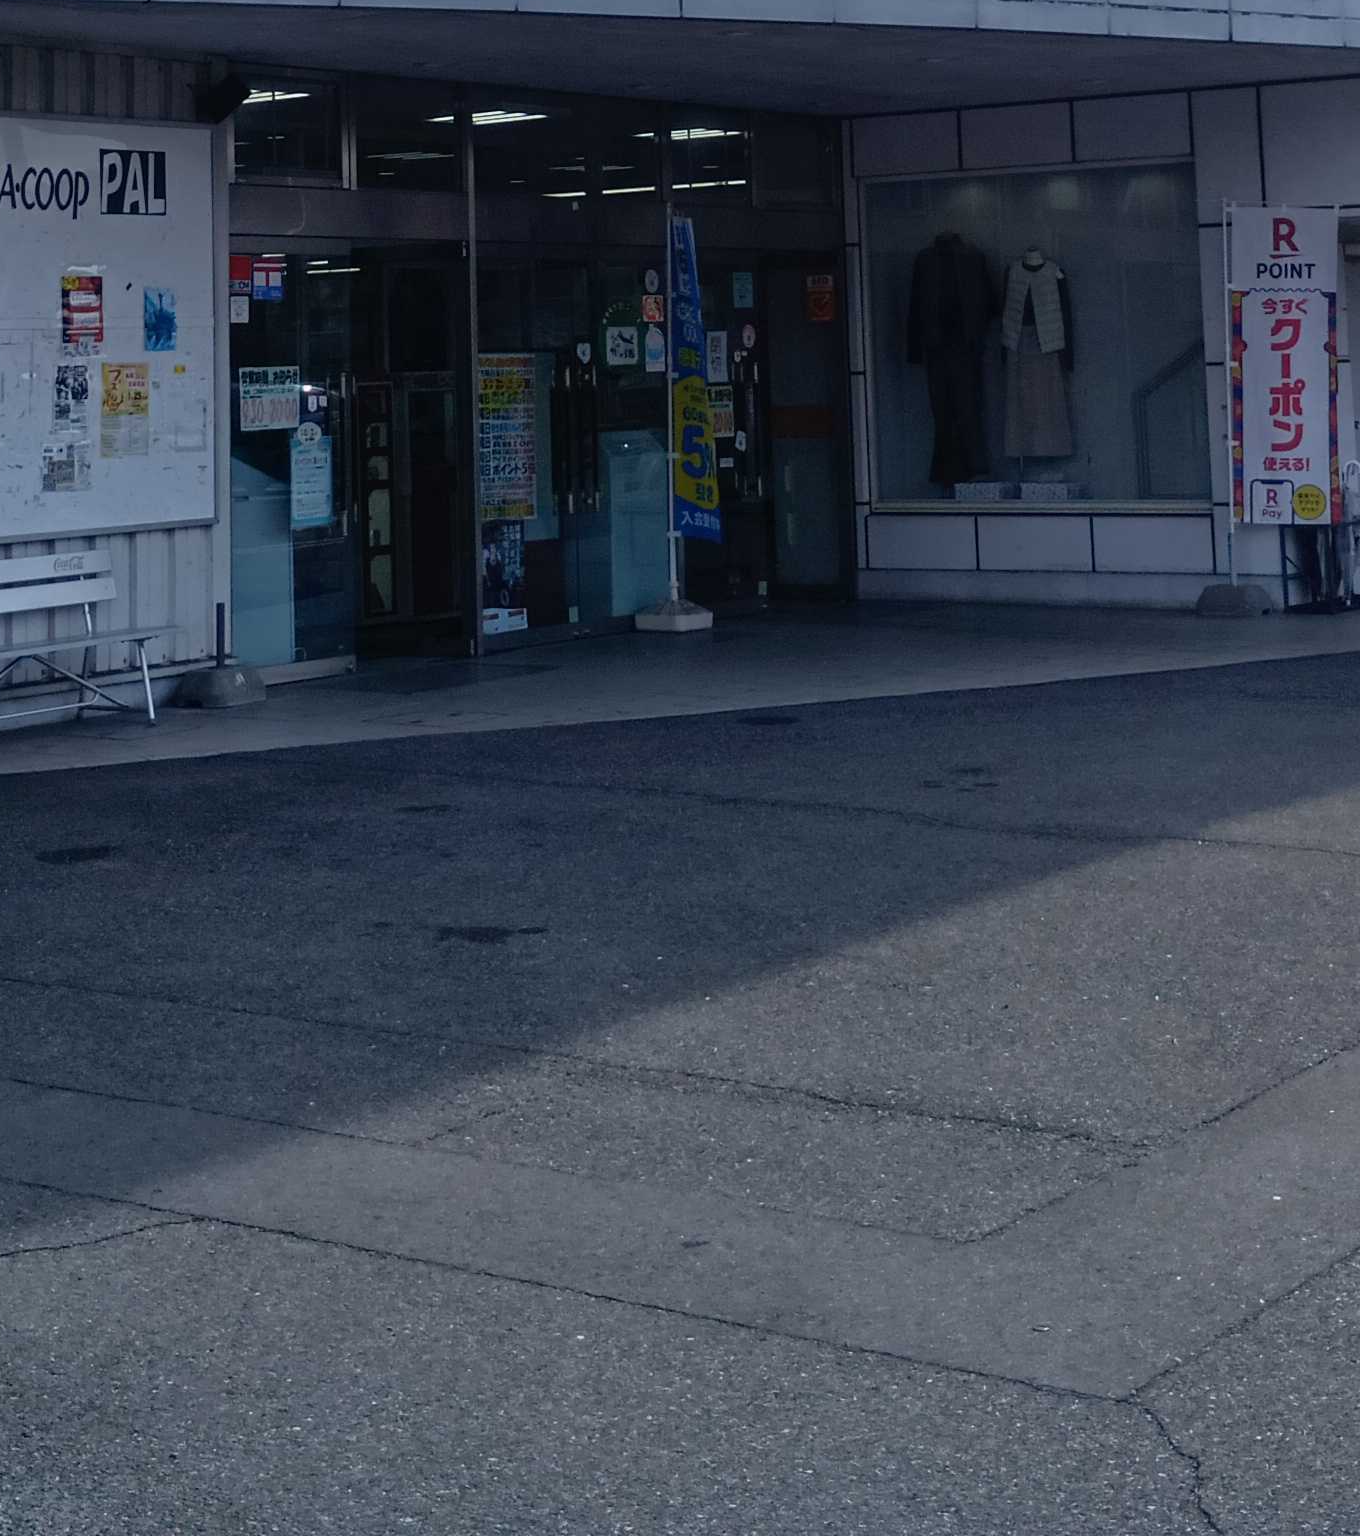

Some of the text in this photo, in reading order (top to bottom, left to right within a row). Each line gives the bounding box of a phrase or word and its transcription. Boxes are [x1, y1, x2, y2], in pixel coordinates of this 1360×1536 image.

[100, 150, 167, 215] PAL
[1272, 217, 1301, 253] R
[1256, 262, 1317, 281] POINT
[1261, 298, 1309, 315] 今すぐ
[1269, 318, 1306, 452] クーポン
[1262, 457, 1311, 473] 使える!
[1266, 488, 1278, 506] R
[1262, 509, 1282, 520] Pay
